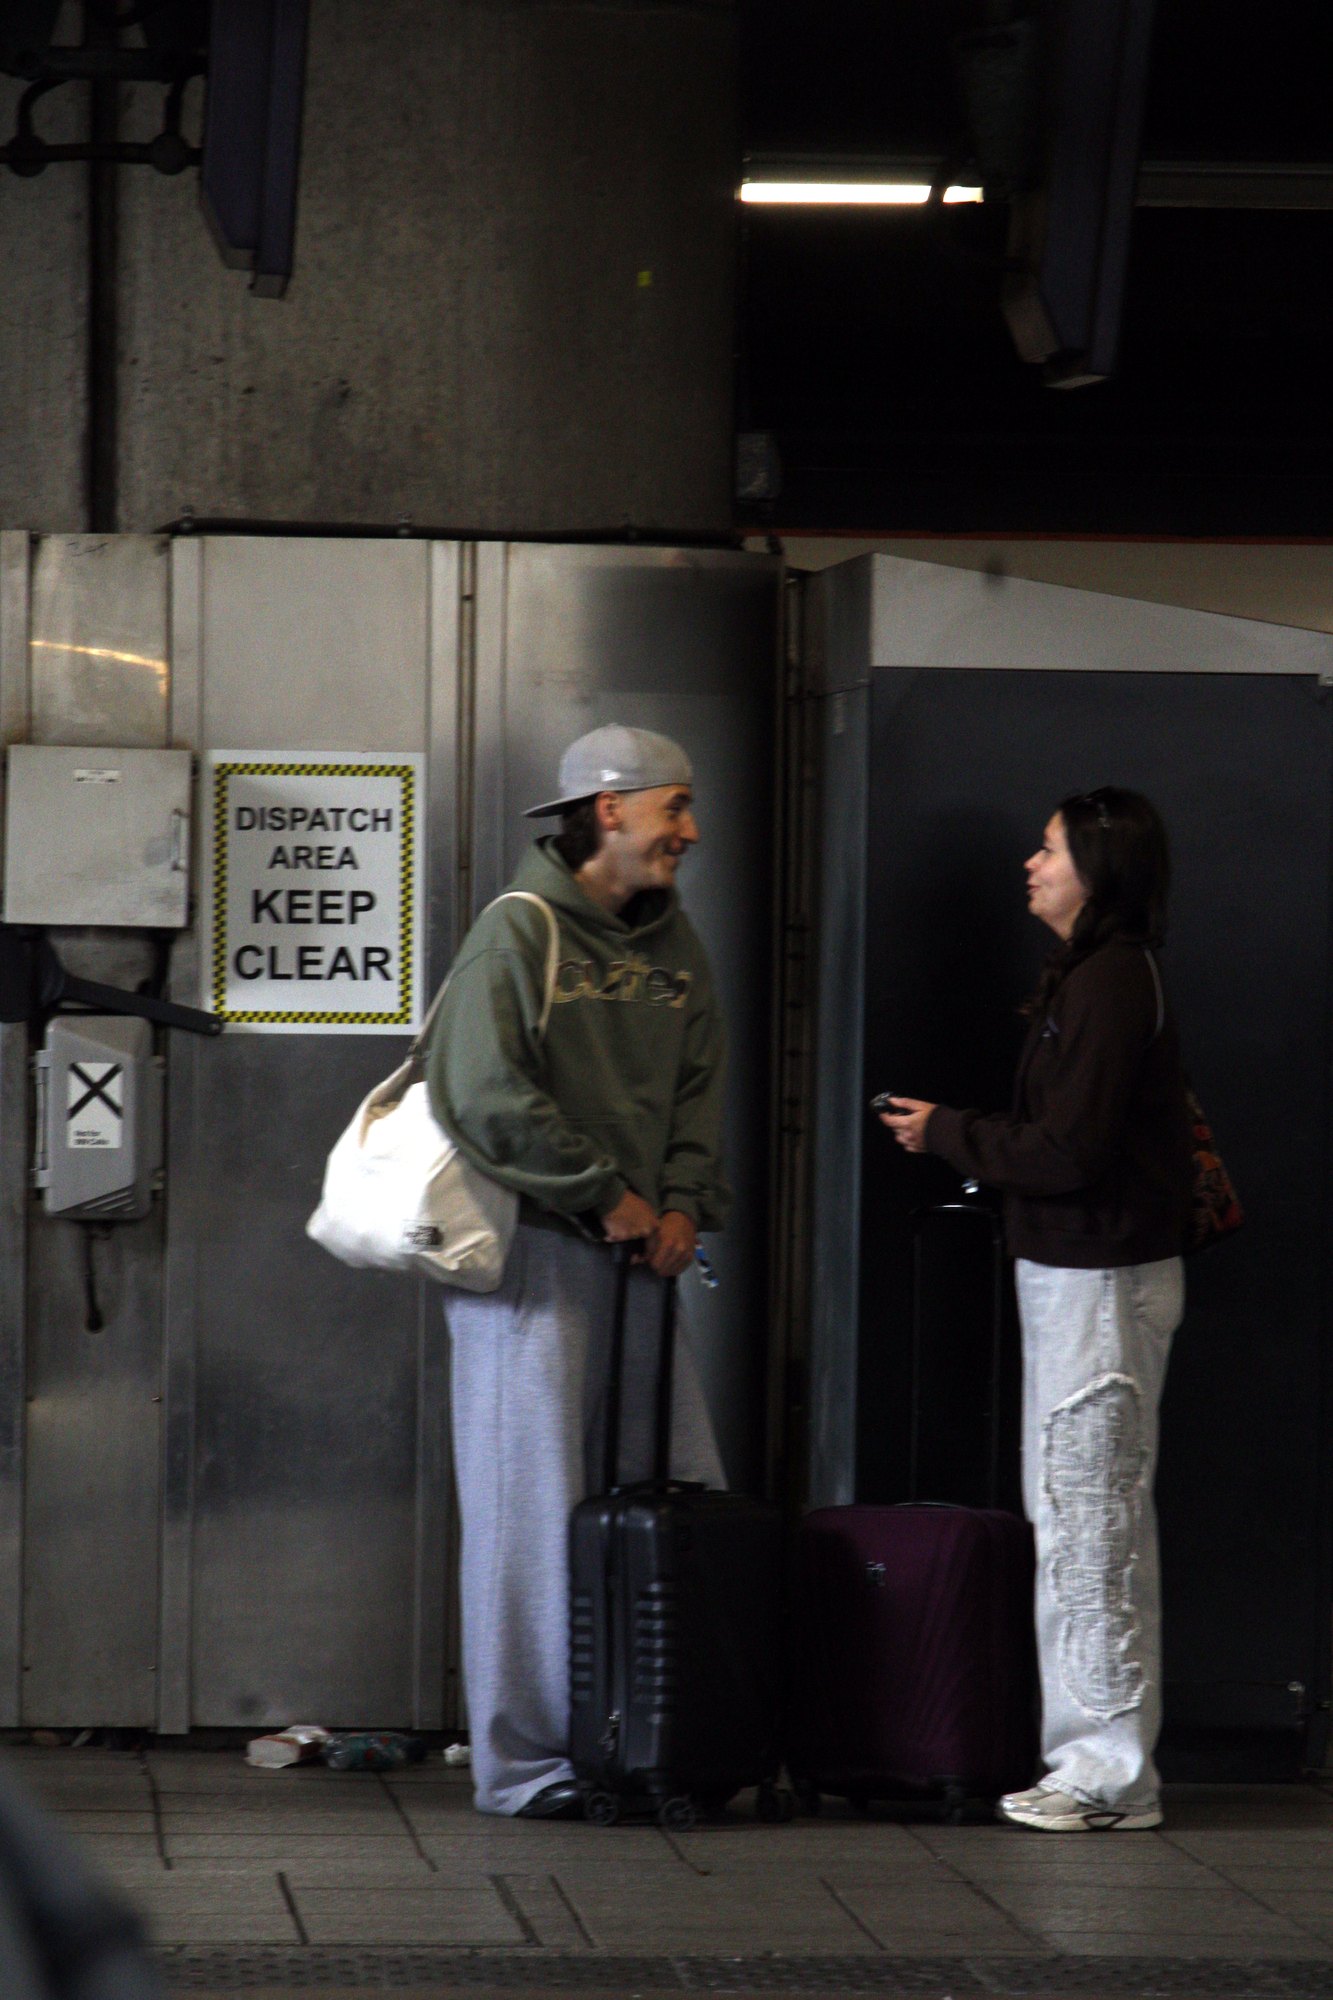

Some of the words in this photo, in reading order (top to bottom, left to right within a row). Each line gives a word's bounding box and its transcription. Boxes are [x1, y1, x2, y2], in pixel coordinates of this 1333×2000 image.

[235, 806, 392, 832] DISPATCH
[268, 845, 359, 870] AREA
[251, 889, 376, 924] KEEP
[234, 945, 392, 981] CLEAR
